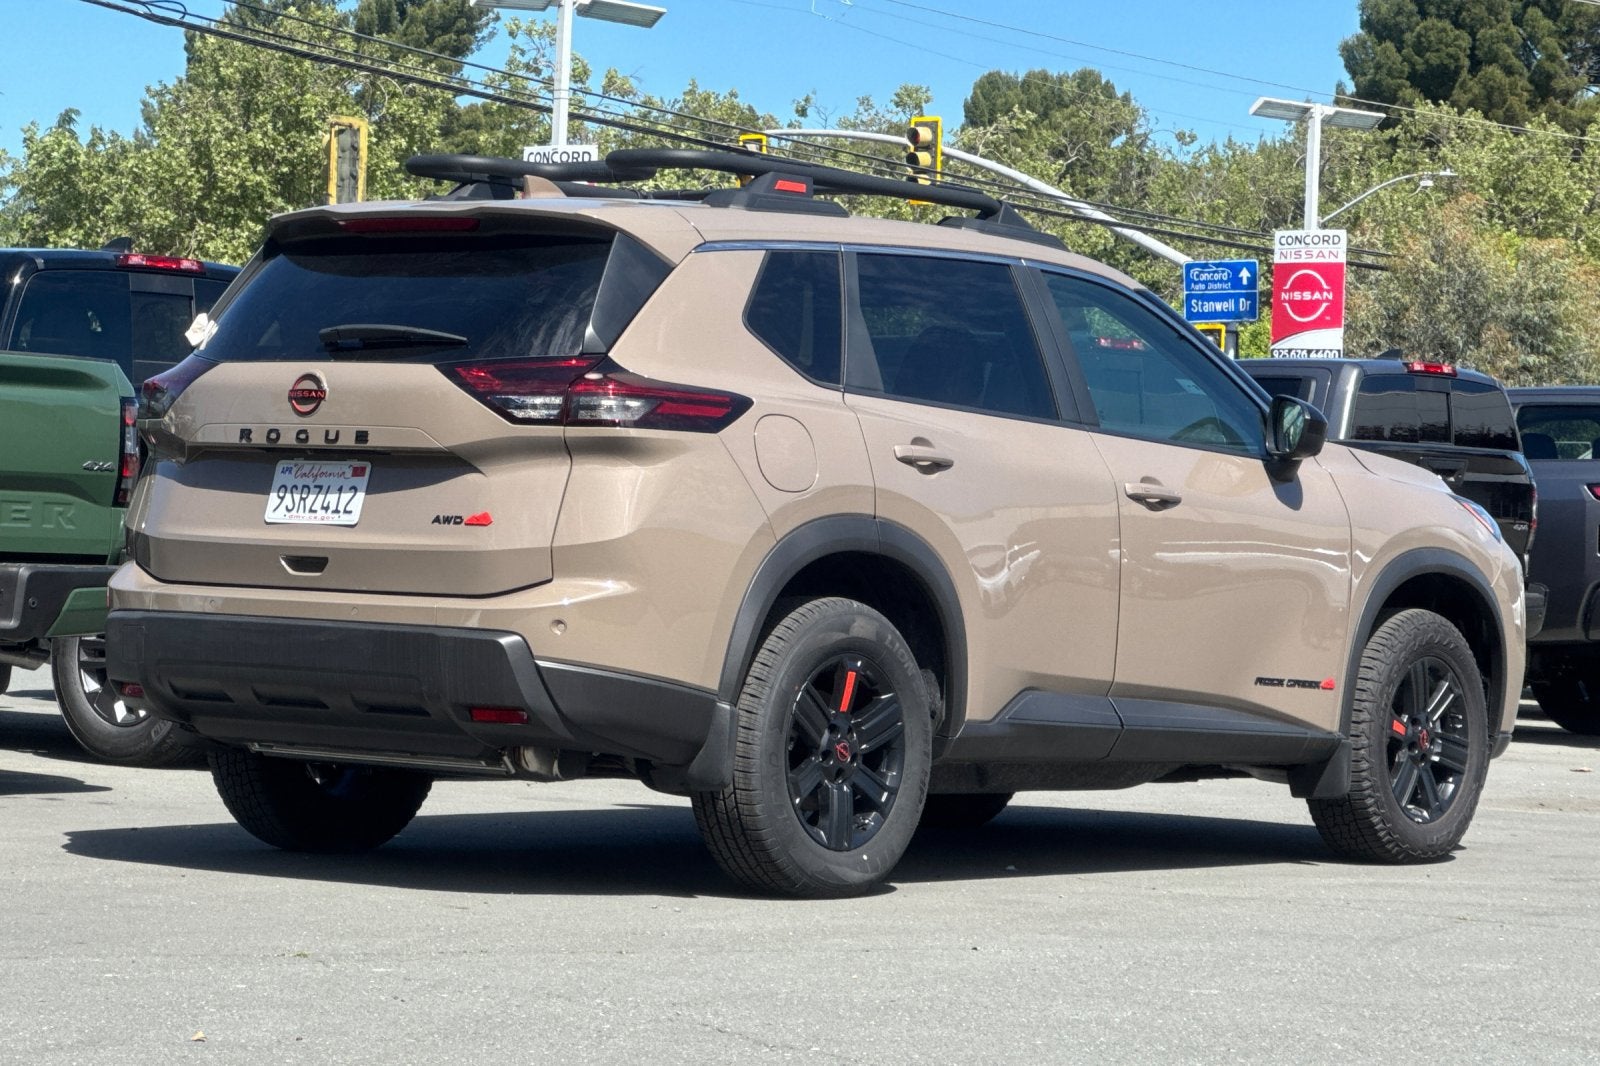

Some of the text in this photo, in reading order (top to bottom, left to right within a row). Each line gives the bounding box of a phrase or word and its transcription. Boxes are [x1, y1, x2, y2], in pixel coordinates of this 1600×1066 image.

[527, 151, 592, 163] CONCORD
[1278, 234, 1342, 246] CONCORD
[1279, 250, 1340, 260] NISSAN
[1193, 270, 1229, 281] Concord
[1190, 282, 1232, 291] Auto District
[1280, 290, 1334, 301] NISSAN
[1190, 298, 1252, 313] Stanwell Dr
[289, 390, 326, 399] NISSAN
[238, 427, 370, 445] ROGUE
[281, 466, 294, 476] APR
[294, 464, 350, 483] California
[272, 484, 359, 515] 9SRZ412
[431, 514, 465, 526] AWD
